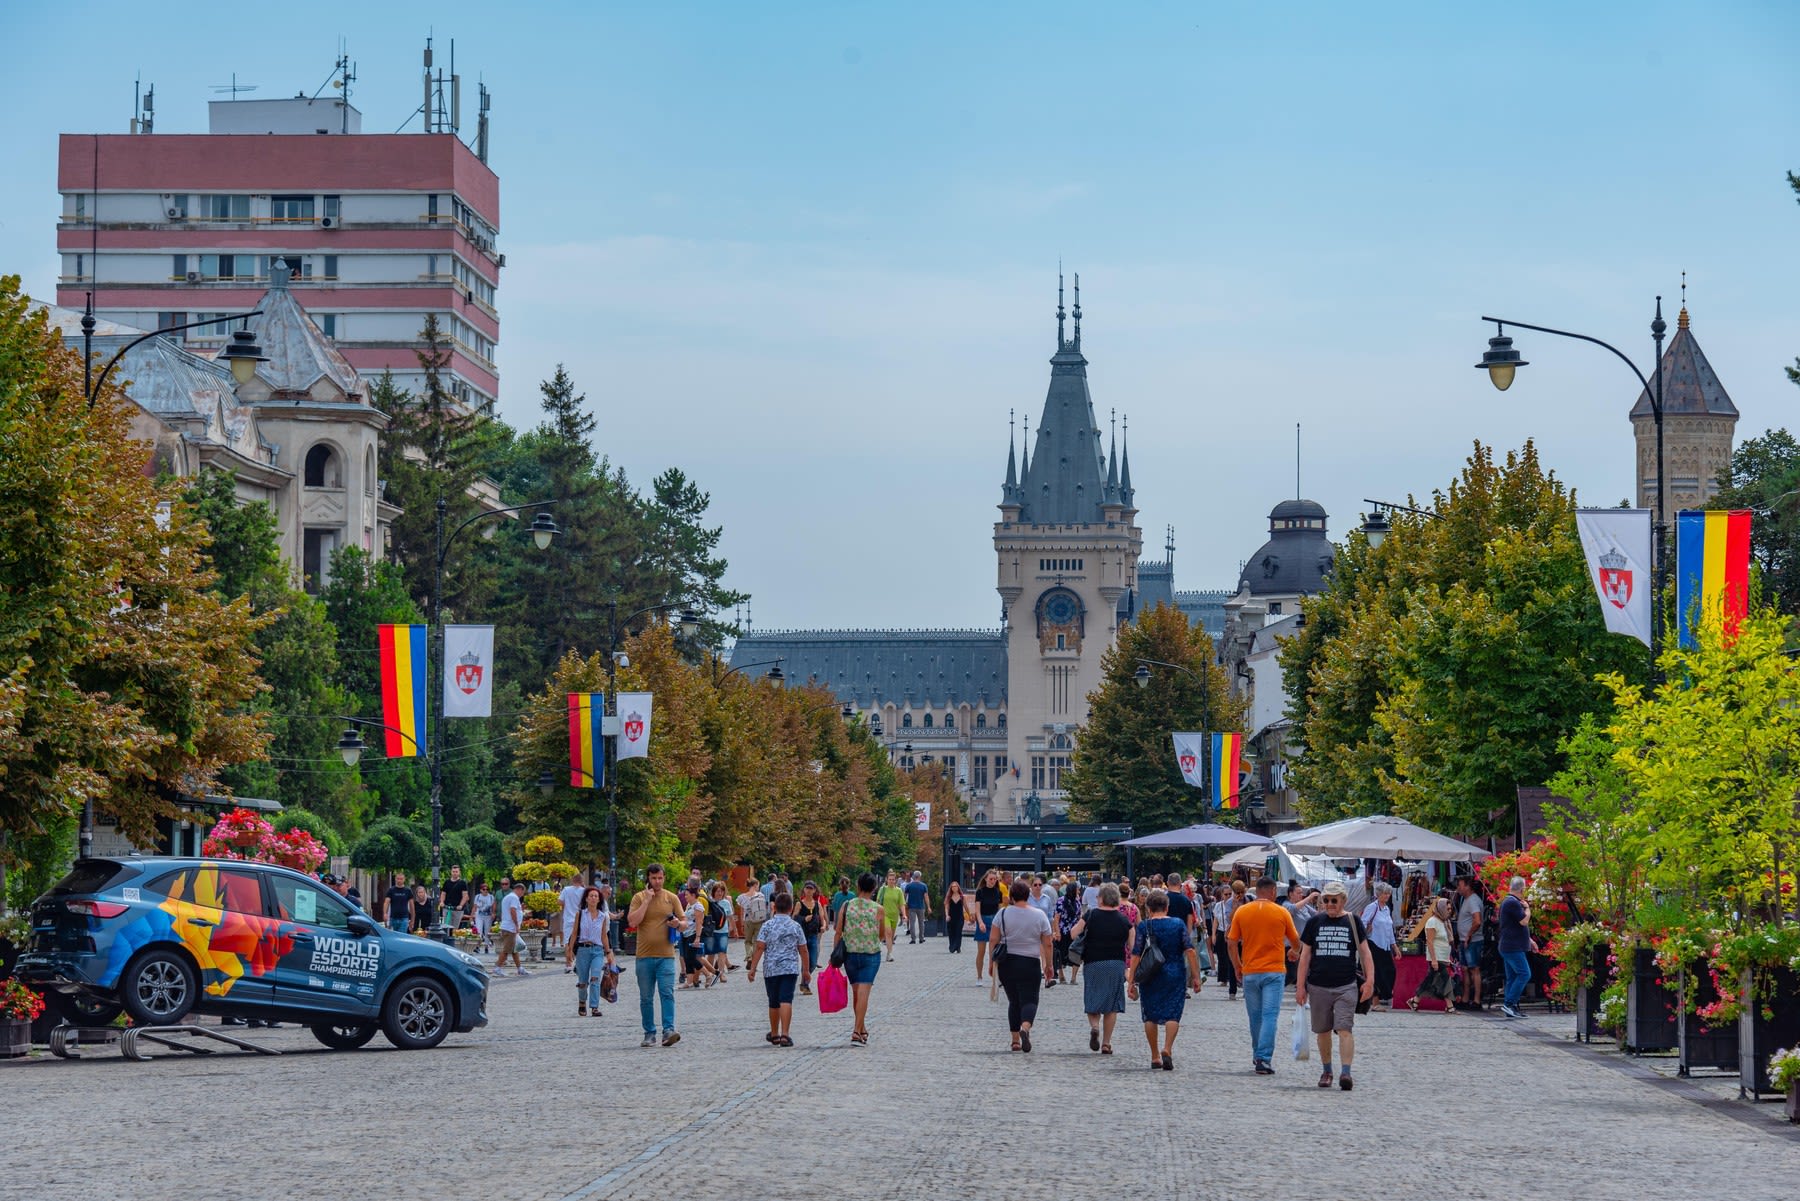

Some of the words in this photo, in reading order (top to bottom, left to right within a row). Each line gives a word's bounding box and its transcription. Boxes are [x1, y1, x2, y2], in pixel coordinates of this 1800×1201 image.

[314, 935, 380, 959] WORLD
[309, 963, 377, 979] CHAMPIONSHIPS
[311, 951, 379, 972] ESPORTS
